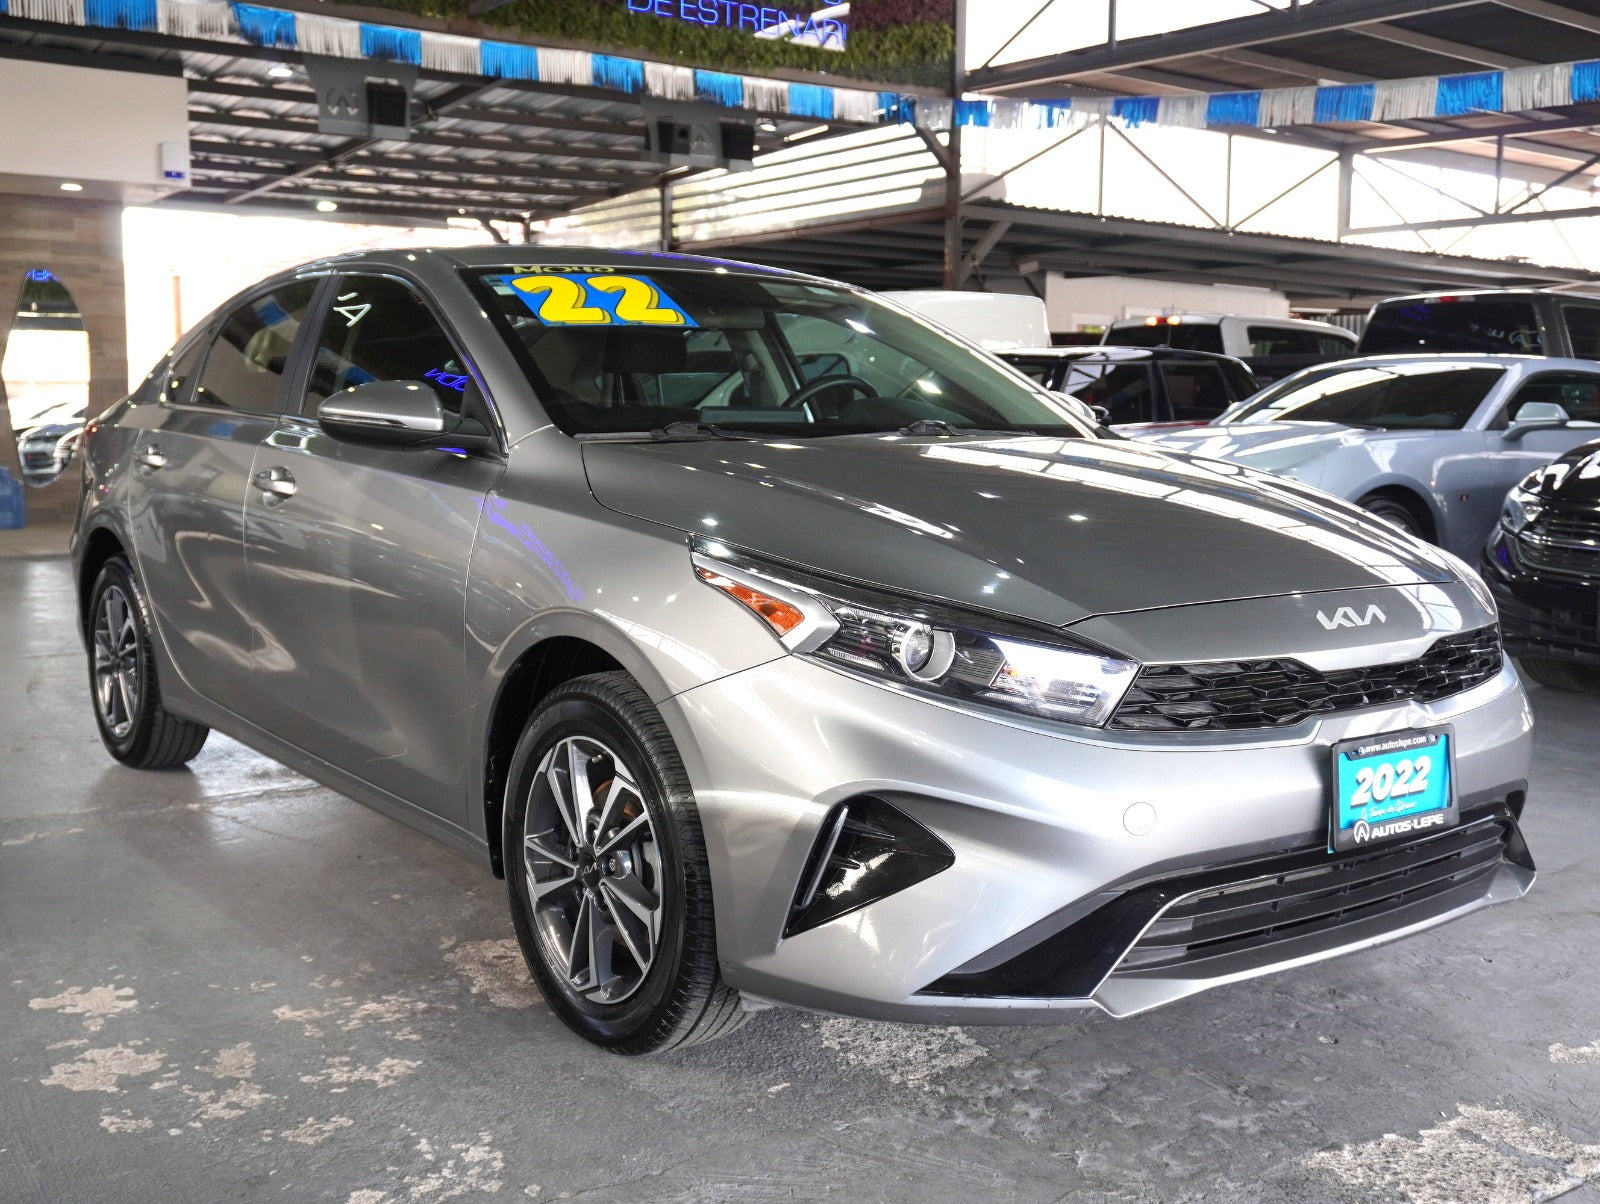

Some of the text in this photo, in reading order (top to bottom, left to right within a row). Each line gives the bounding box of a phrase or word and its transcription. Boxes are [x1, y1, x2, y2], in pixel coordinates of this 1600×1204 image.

[511, 275, 685, 325] 22
[1316, 604, 1387, 630] KIA
[1364, 735, 1428, 753] www.autoslepe.com
[1350, 755, 1432, 807] 2022
